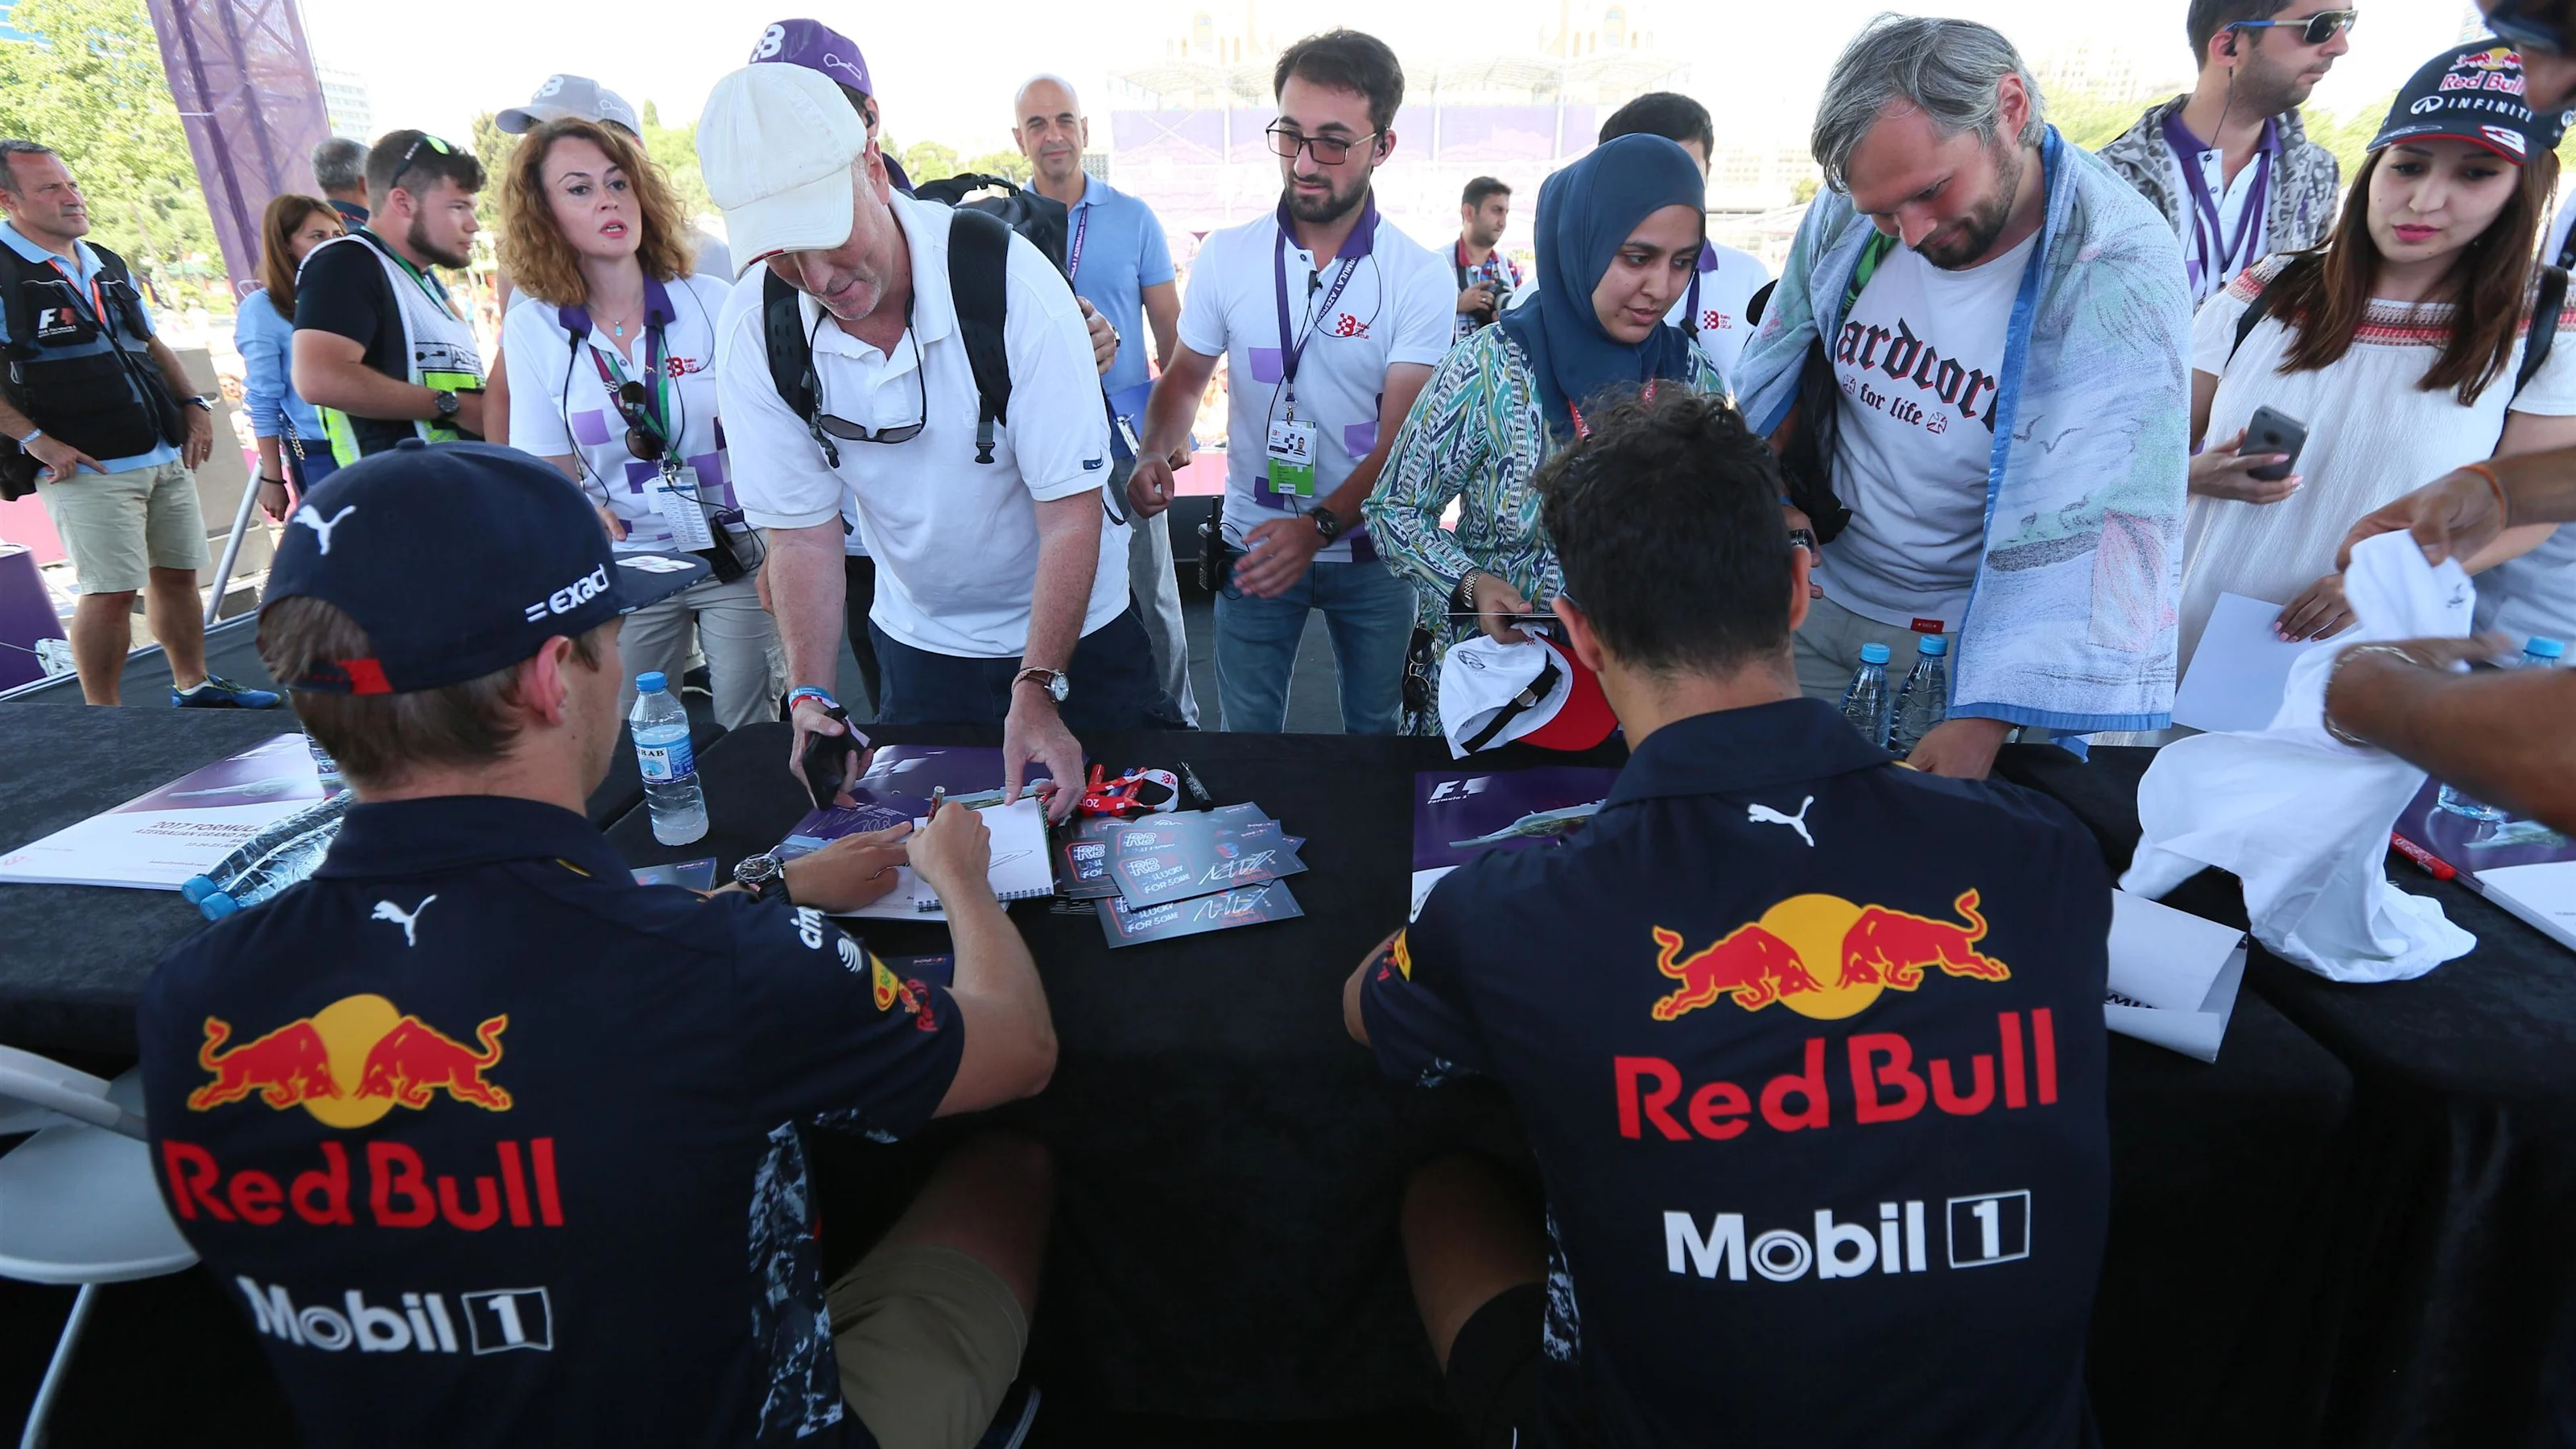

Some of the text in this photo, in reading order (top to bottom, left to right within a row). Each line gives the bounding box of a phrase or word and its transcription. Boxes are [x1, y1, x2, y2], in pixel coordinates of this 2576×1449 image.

[2439, 71, 2483, 91] Red
[2448, 97, 2533, 122] INFINITI
[2479, 125, 2528, 157] 3
[1860, 382, 1924, 426] for life
[1427, 795, 1461, 804] Formula
[149, 821, 194, 829] 2017
[1143, 873, 1191, 894] FOR SOME
[1125, 911, 1179, 934] FOR SOME
[1614, 1008, 2058, 1141] Red Bull
[163, 1137, 564, 1231] Red Bull
[1663, 1201, 1927, 1282] Mobil
[236, 1275, 459, 1353] Mobil
